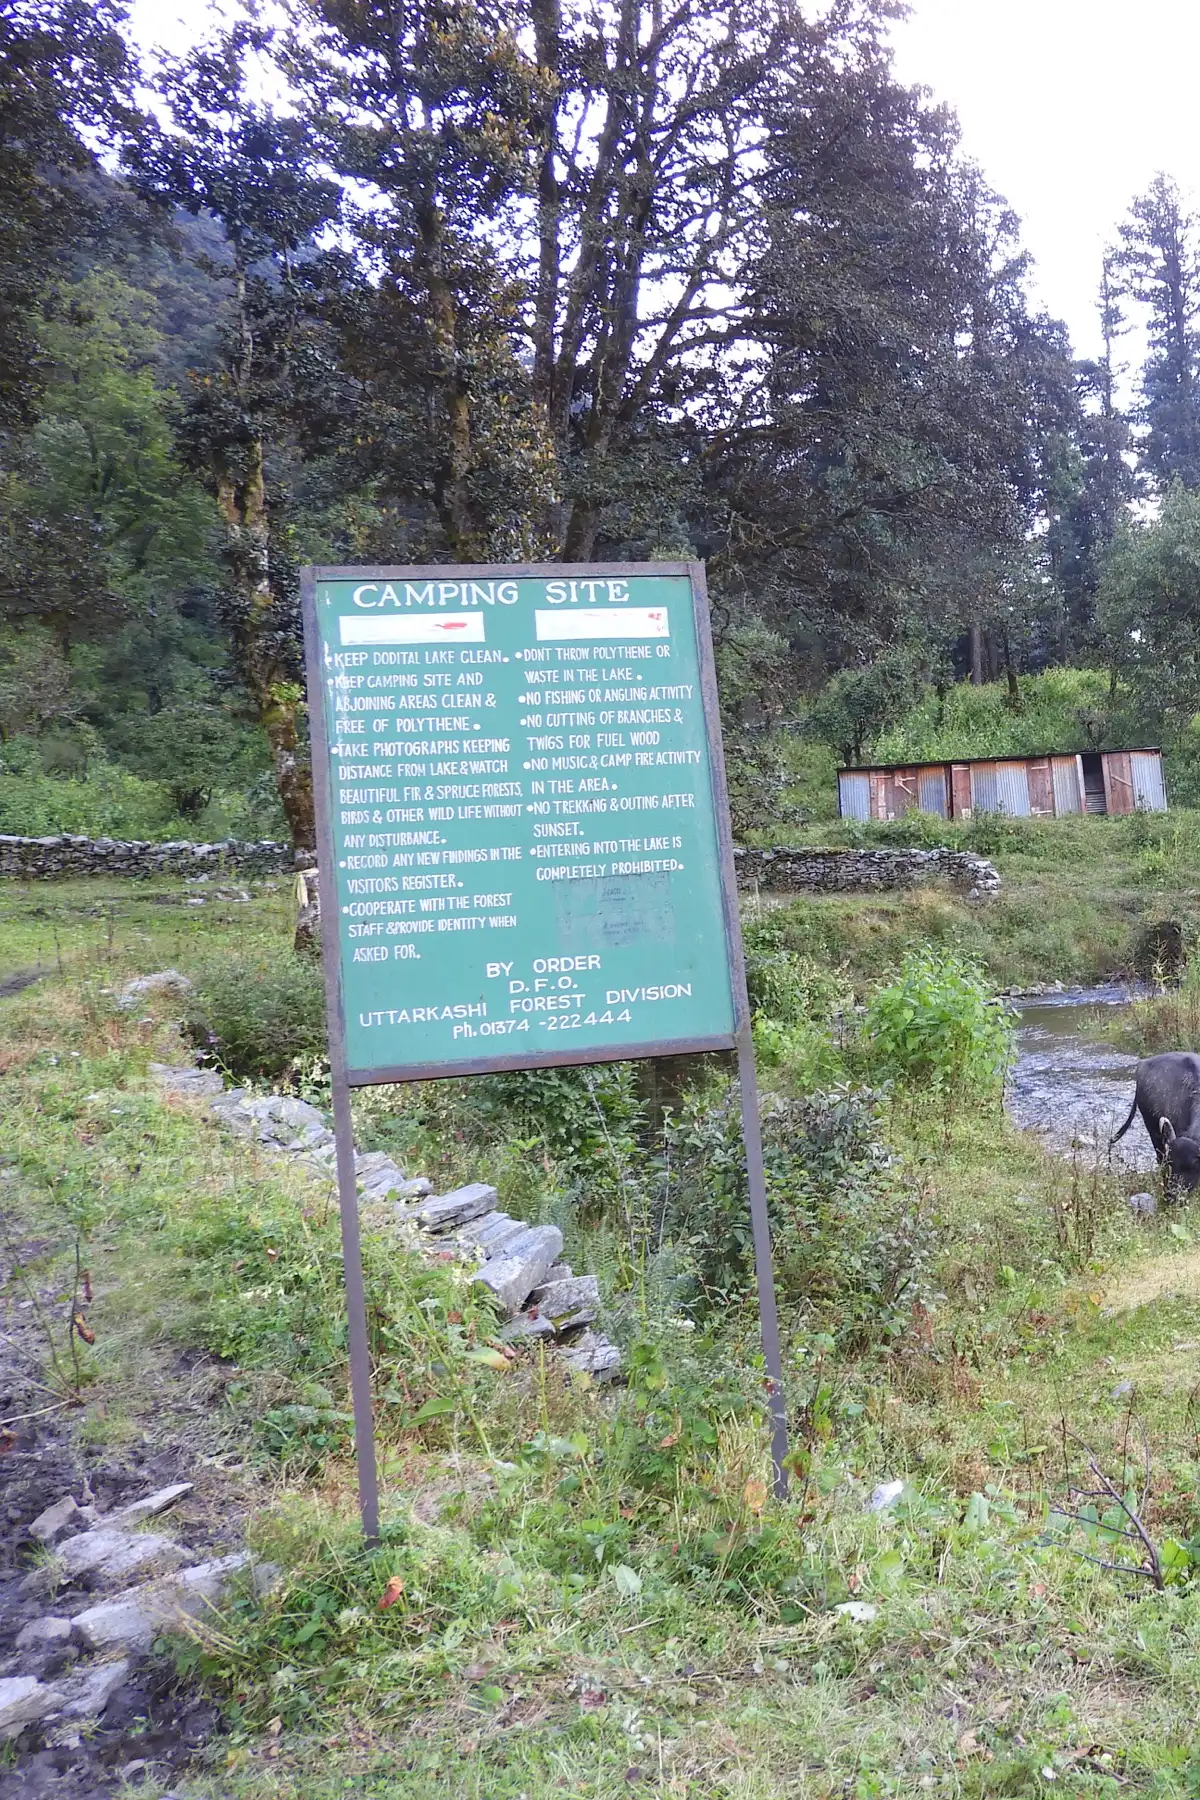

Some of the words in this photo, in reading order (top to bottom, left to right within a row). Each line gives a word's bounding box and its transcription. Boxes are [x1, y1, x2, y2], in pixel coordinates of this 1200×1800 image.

[353, 582, 519, 607] CAMPING
[546, 581, 629, 603] SITE
[334, 653, 368, 666] KEEP
[374, 651, 420, 665] DODITAL
[426, 651, 454, 664] LAKE
[555, 647, 589, 660] THROW
[594, 646, 651, 659] POLYTHENE
[656, 645, 670, 657] OR
[335, 676, 365, 689] KEEP
[367, 674, 417, 688] CAMPING
[423, 673, 451, 686] SITE
[457, 672, 483, 685] AND
[524, 670, 558, 684] WASTE
[564, 670, 574, 682] IN
[577, 669, 598, 681] THE
[399, 695, 437, 709] AREAS
[442, 694, 481, 708] CLEAN
[485, 693, 496, 707] &
[526, 692, 541, 705] NO
[545, 690, 585, 704] FISHING
[589, 689, 601, 703] OR
[605, 688, 647, 702] ANGLING
[650, 686, 693, 700] ACTIVITY
[336, 720, 365, 734] FREE
[373, 719, 389, 732] OF
[527, 715, 542, 727] NO
[546, 712, 595, 726] CUTTING
[600, 711, 615, 724] OF
[618, 709, 671, 723] BRANCHES
[674, 709, 683, 724] &
[337, 743, 368, 757] TAKE
[374, 740, 459, 756] PHOTOGRAPHS
[463, 739, 510, 753] KEEPING
[527, 736, 563, 751] TWIGS
[569, 735, 590, 748] FOR
[597, 733, 625, 747] FUEL
[630, 732, 660, 745] WOOD
[339, 765, 392, 780] DISTANCE
[398, 764, 426, 777] FROM
[431, 762, 459, 776] LAKE
[460, 761, 469, 775] &
[470, 760, 508, 773] WATCH
[531, 758, 548, 770] NO
[552, 756, 588, 770] MUSIC
[589, 756, 598, 770] &
[601, 753, 632, 767] CAMP
[635, 752, 654, 766] FIRE
[656, 751, 701, 765] ACTIVITY
[340, 788, 400, 804] BEAUTIFUL
[404, 787, 421, 801] FIR
[424, 785, 434, 800] &
[436, 785, 479, 800] SPRUCE
[532, 781, 544, 795] IN
[548, 779, 574, 793] THE
[534, 802, 550, 814] NO
[610, 798, 619, 811] &
[620, 795, 659, 810] OUTING
[662, 794, 695, 809] AFTER
[341, 810, 370, 825] BIRDS
[373, 810, 382, 824] &
[387, 808, 424, 823] OTHER
[428, 807, 454, 821] WILD
[459, 806, 482, 819] LIFE
[483, 804, 523, 818] WITHOUT
[533, 822, 584, 837] SUNSET.
[344, 835, 365, 848] ANY
[369, 831, 447, 847] DISTURBANCE.
[537, 843, 590, 858] ENTERING
[593, 841, 617, 854] INTO
[619, 838, 641, 852] THE
[644, 837, 670, 851] LAKE
[673, 836, 682, 849] IS
[348, 855, 388, 869] RECORD
[393, 853, 414, 867] ANY
[417, 852, 440, 865] NEW
[443, 849, 488, 864] FINDINGS
[490, 849, 499, 861] IN
[499, 847, 522, 860] THE
[536, 864, 606, 880] COMPLETELY
[612, 859, 684, 875] PROHIBITED.
[347, 877, 398, 894] VISITORS
[402, 874, 464, 891] REGISTER.
[350, 899, 416, 916] COOPERATE
[420, 897, 445, 912] WITH
[447, 896, 469, 910] THE
[474, 893, 512, 908] FOREST
[349, 923, 384, 937] STAFF
[438, 917, 486, 931] IDENTITY
[489, 916, 517, 928] WHEN
[353, 946, 388, 962] ASKED
[394, 944, 421, 960] FOR.
[486, 961, 514, 978] BY
[532, 955, 601, 974] ORDER
[360, 1002, 487, 1027] UTTARKASHI
[510, 994, 587, 1014] FOREST
[606, 983, 693, 1005] DIVISION
